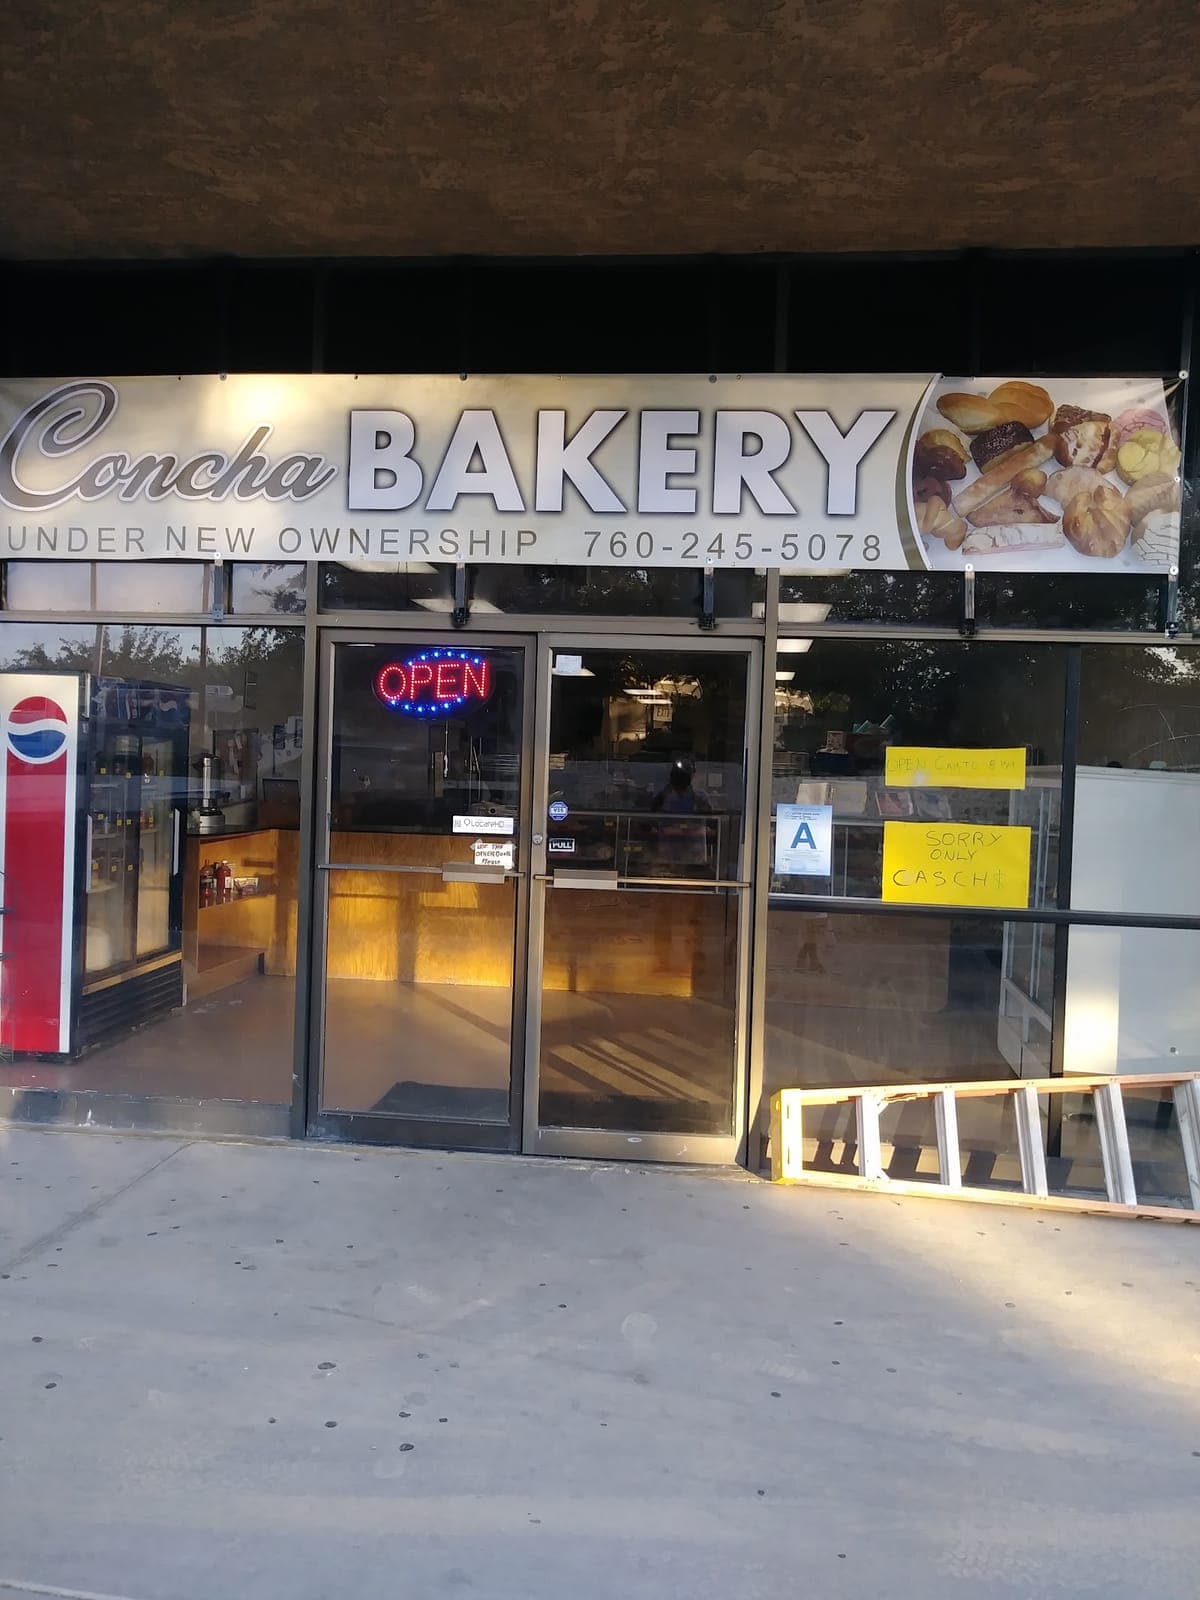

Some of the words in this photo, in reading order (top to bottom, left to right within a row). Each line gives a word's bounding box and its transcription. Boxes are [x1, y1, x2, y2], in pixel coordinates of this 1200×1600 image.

[0, 379, 338, 511] Concha
[348, 409, 897, 515] BAKERY
[7, 526, 145, 553] UNDER
[166, 526, 256, 553] NEW
[278, 527, 538, 556] OWNERSHIP
[584, 531, 881, 562] 760-245-5078
[378, 662, 488, 701] OPEN
[552, 841, 572, 849] PULL
[790, 822, 817, 849] A
[926, 830, 1002, 847] SORRY
[930, 849, 977, 861] ONLY
